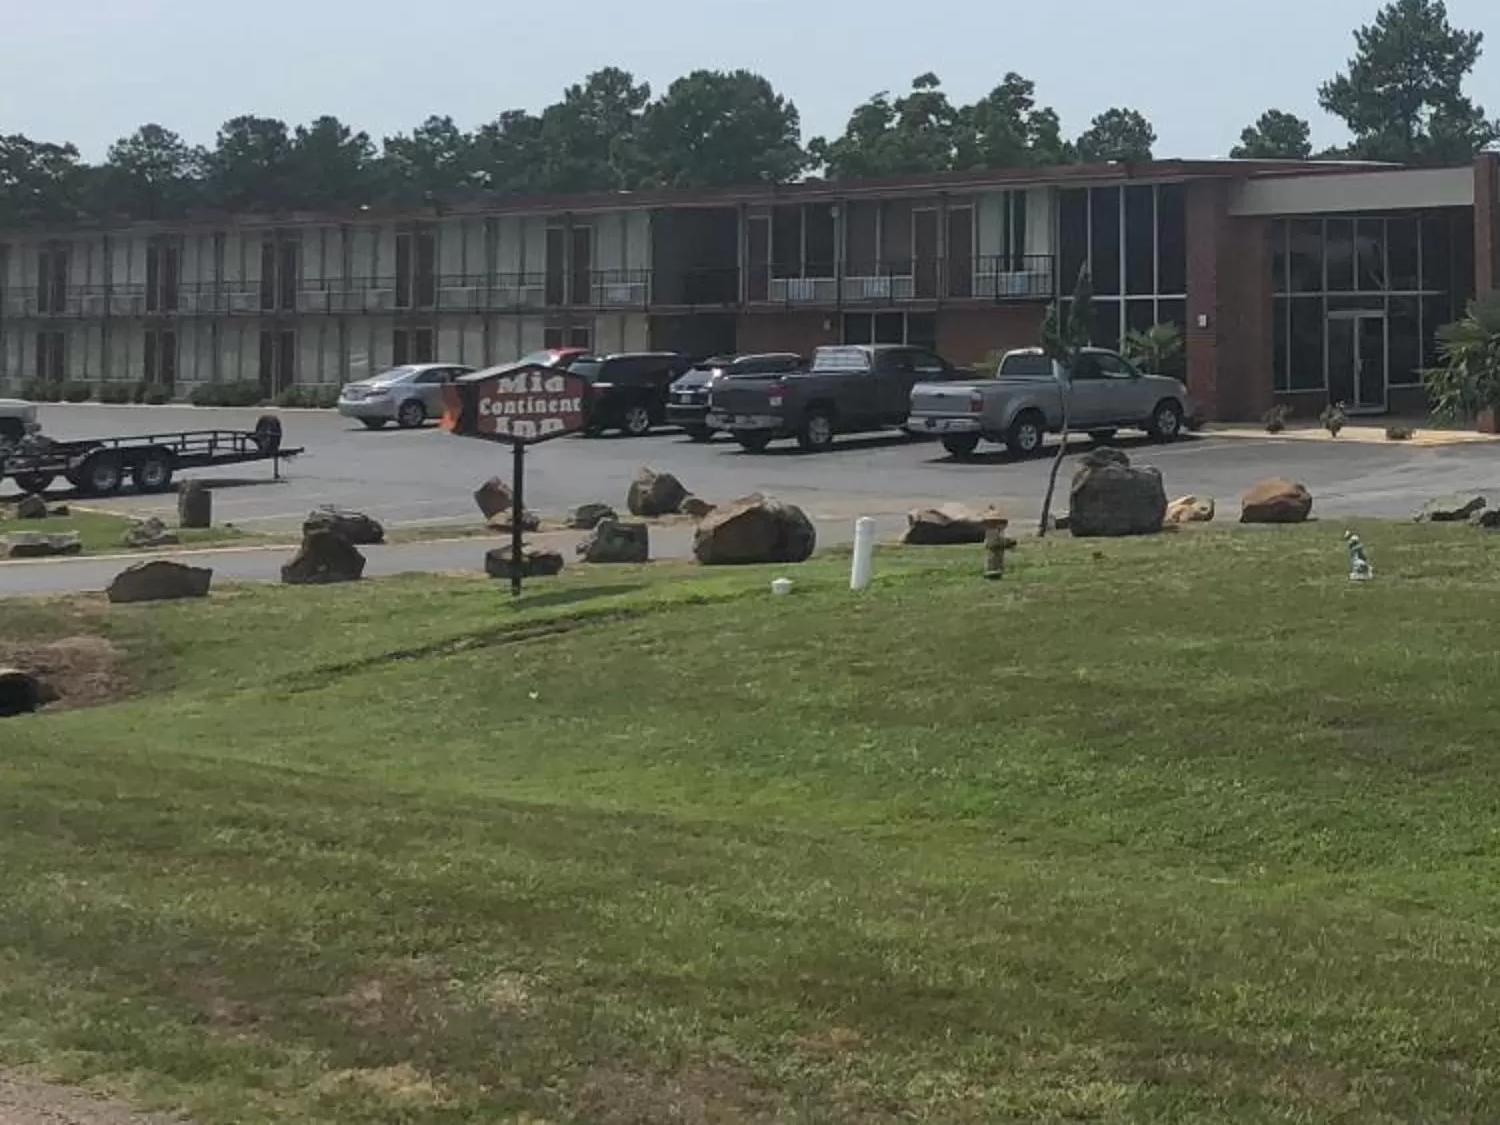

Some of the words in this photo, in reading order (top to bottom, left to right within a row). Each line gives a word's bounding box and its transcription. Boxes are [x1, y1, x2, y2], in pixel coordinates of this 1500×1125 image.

[497, 372, 566, 394] Mid
[479, 397, 581, 416] Continent
[495, 416, 566, 438] Inn
